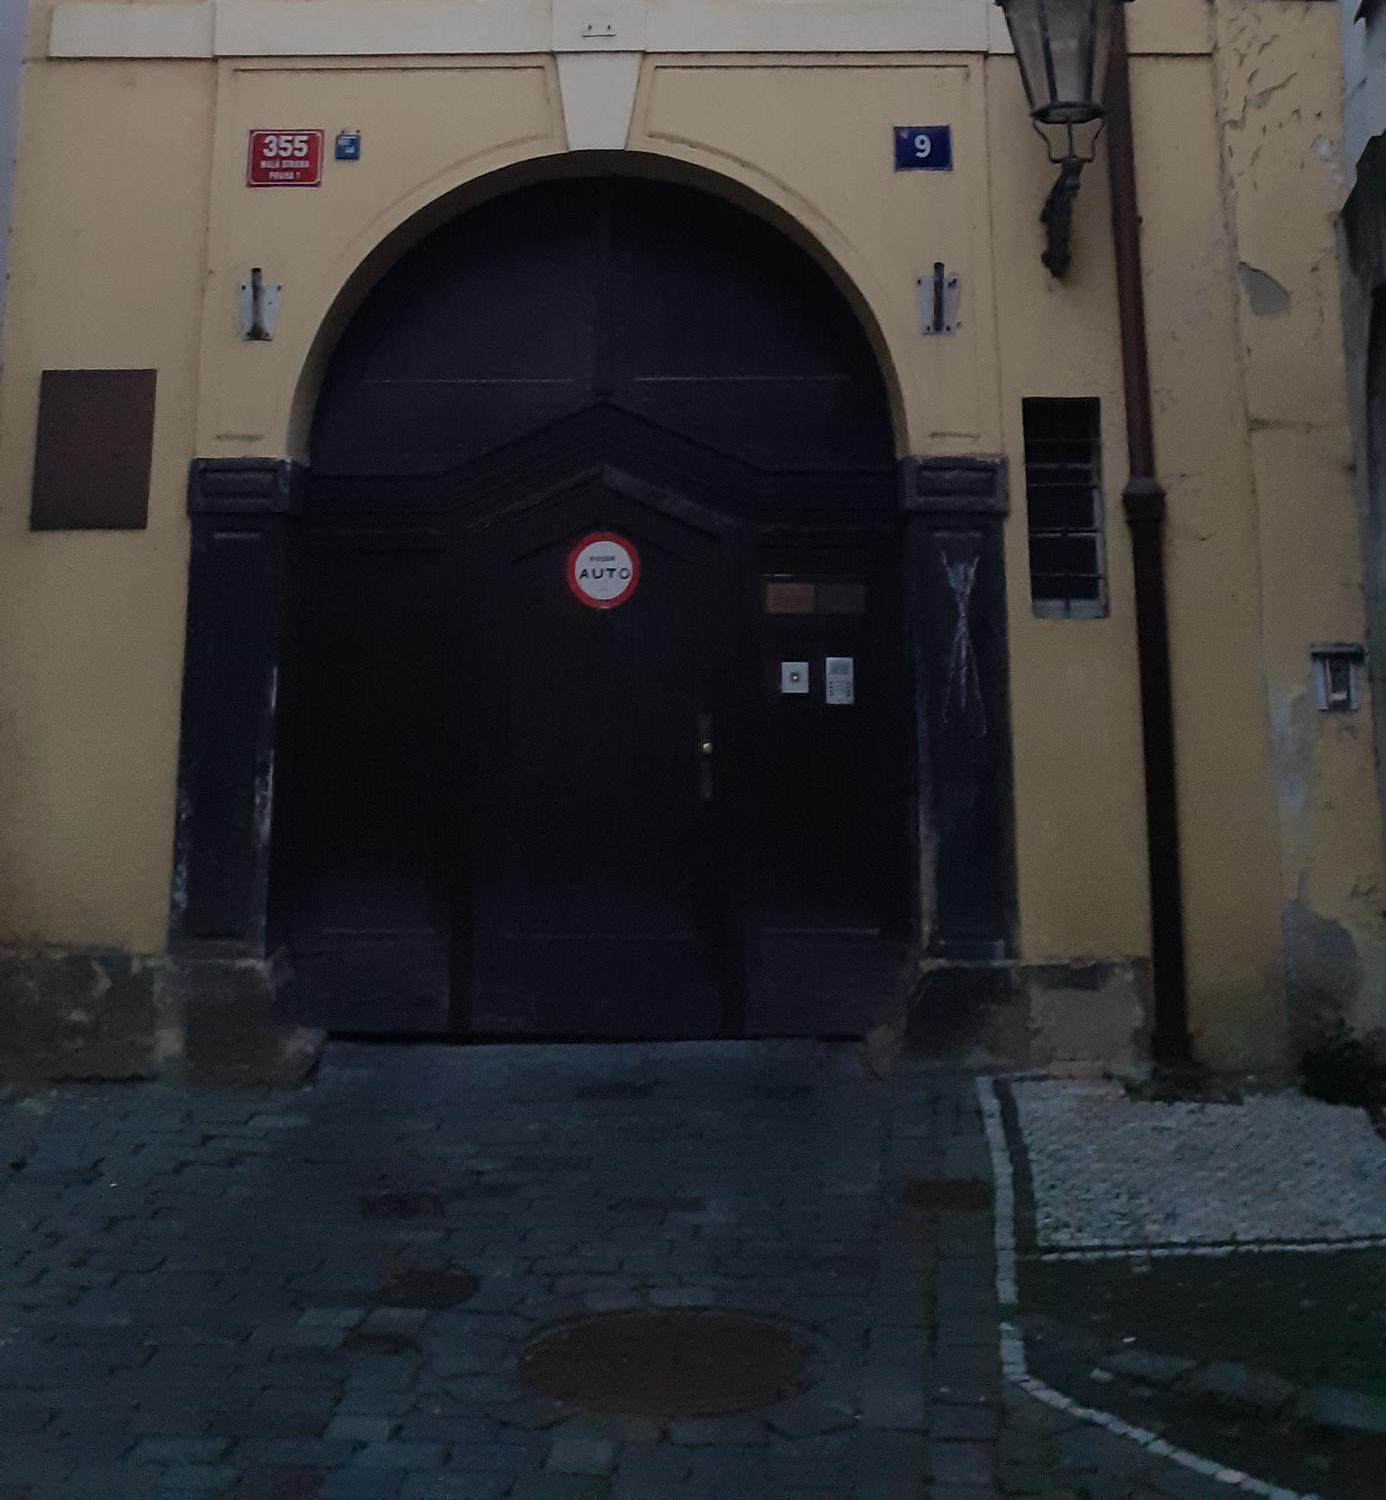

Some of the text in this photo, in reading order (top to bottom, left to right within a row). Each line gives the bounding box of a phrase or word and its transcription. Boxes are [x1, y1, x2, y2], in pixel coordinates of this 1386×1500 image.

[263, 134, 309, 157] 355
[914, 134, 932, 158] 9
[579, 568, 630, 580] AUTO
